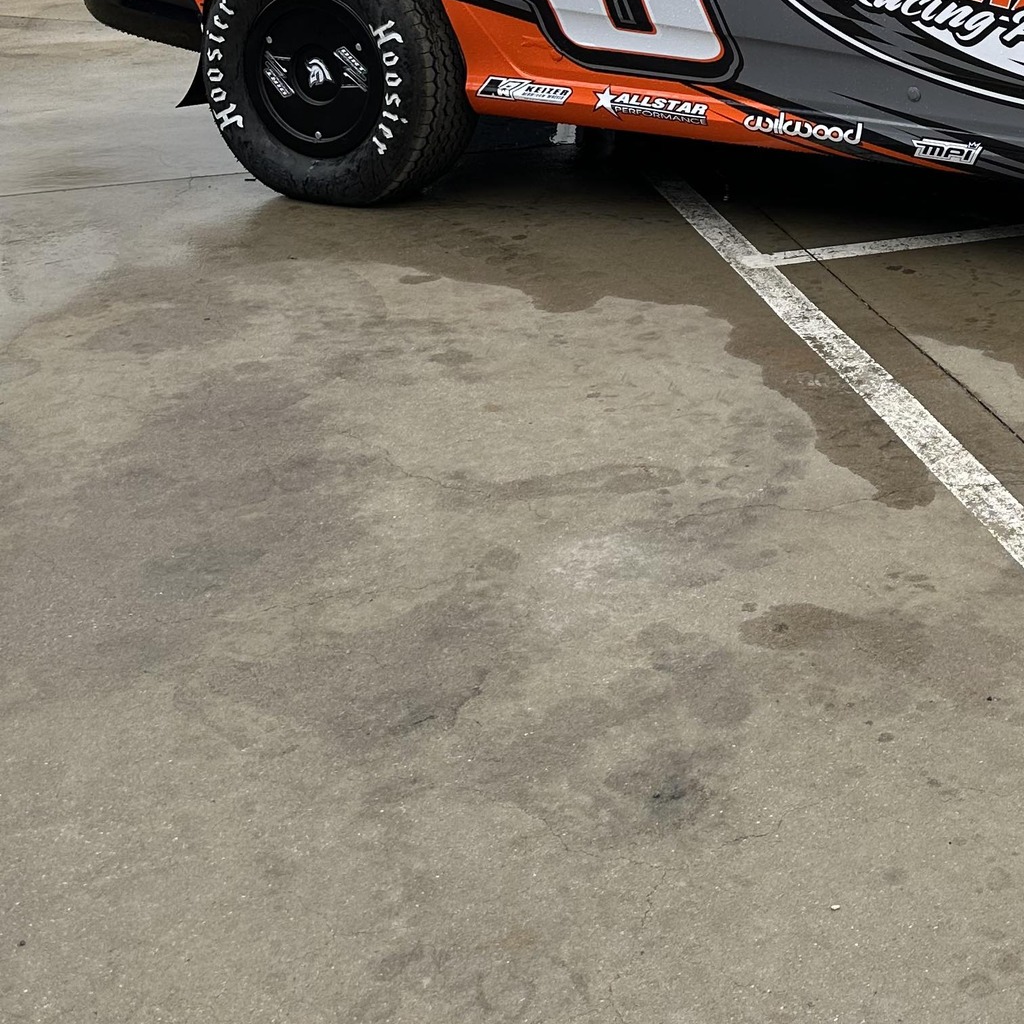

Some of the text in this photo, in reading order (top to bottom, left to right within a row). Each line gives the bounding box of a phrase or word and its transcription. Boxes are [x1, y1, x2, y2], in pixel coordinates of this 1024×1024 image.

[368, 18, 409, 156] Hoosier
[524, 84, 570, 97] KEIZER
[613, 92, 709, 116] ALLSTAR
[614, 105, 707, 126] PERFORMANCE
[743, 111, 863, 145] wilwood
